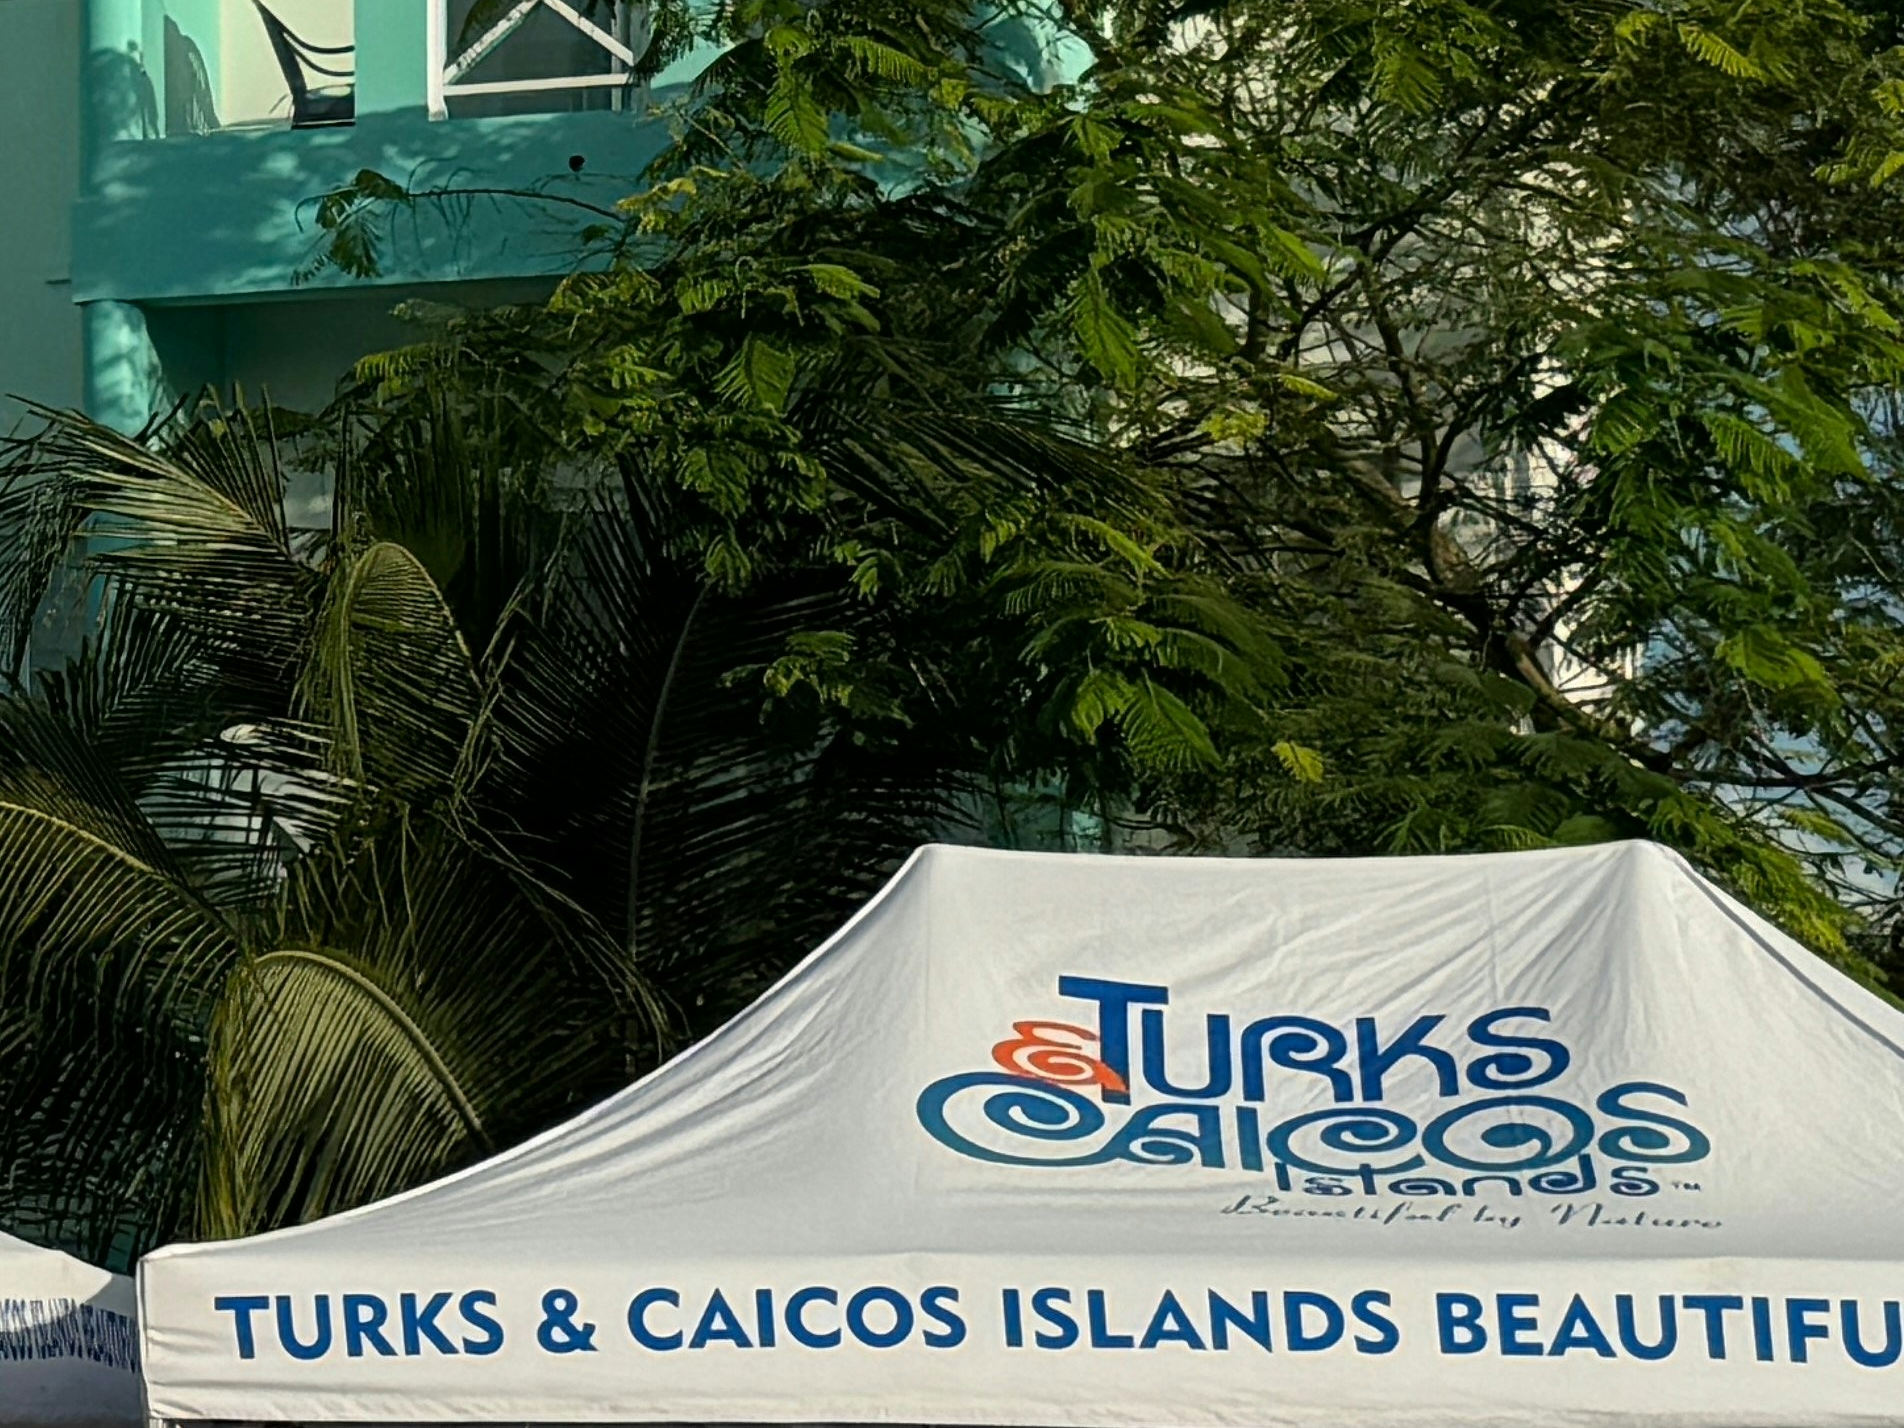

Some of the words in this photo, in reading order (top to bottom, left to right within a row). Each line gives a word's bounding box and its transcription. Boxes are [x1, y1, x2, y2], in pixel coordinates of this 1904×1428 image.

[214, 1290, 505, 1360] TURKS
[537, 1288, 600, 1353] &
[627, 1286, 967, 1351] CAICOS
[1003, 1287, 1398, 1353] ISLANDS
